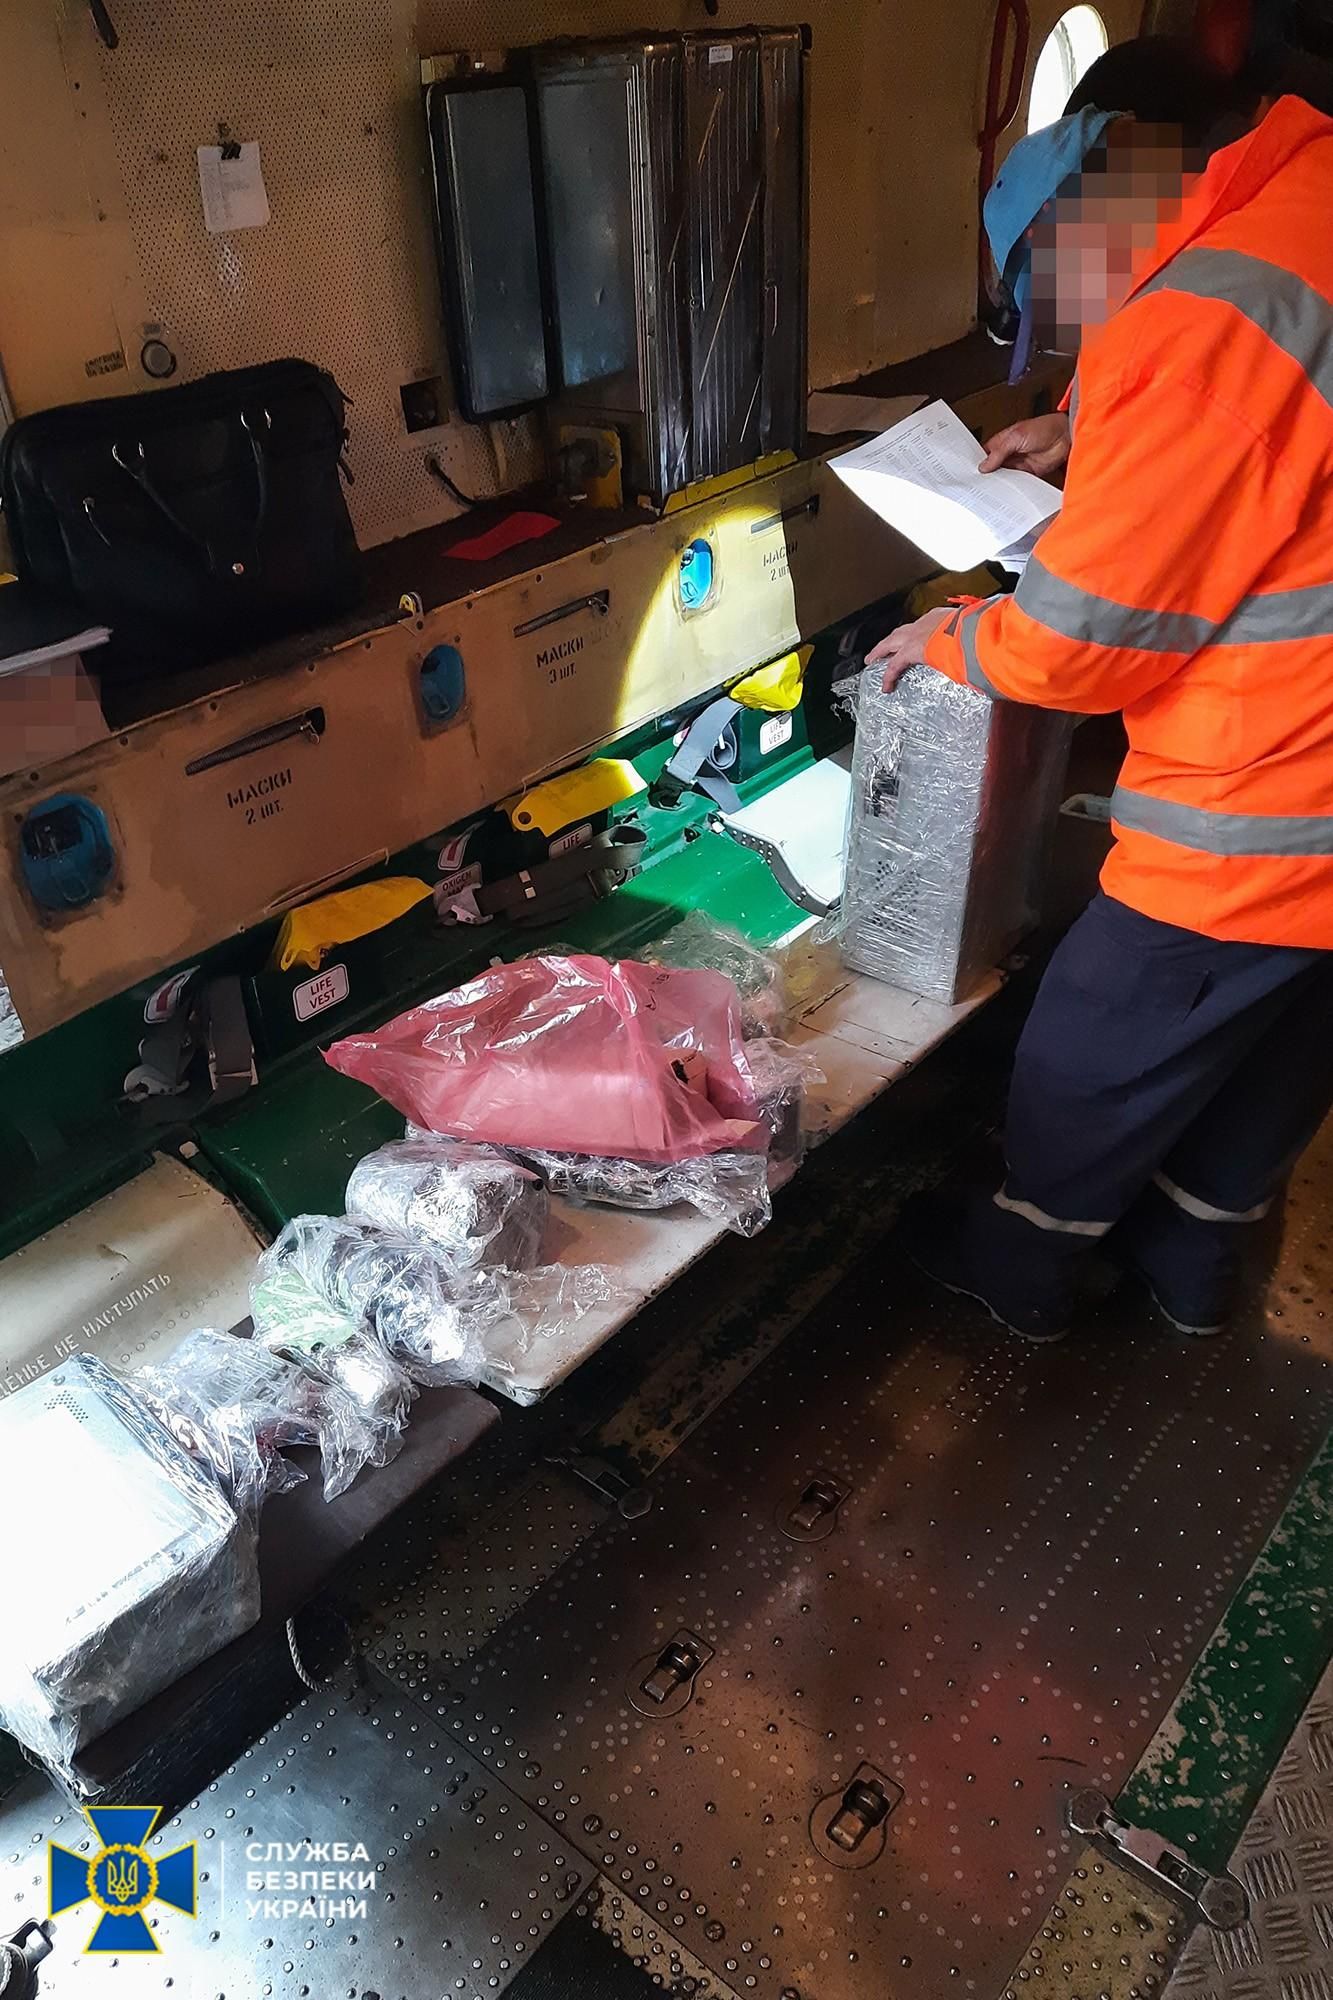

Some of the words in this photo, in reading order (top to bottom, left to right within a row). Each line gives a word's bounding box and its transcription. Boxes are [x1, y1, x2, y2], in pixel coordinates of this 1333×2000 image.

[770, 568, 777, 581] 2
[536, 636, 584, 668] МАСКИ
[549, 668, 557, 684] 3
[227, 767, 292, 809] МАСКИ
[246, 808, 256, 825] 2
[562, 832, 581, 850] LIFE
[310, 976, 332, 996] LIFE
[309, 987, 336, 1009] VEST
[54, 1334, 80, 1358] НЕ
[82, 1273, 171, 1338] НАСТУПАТЬ
